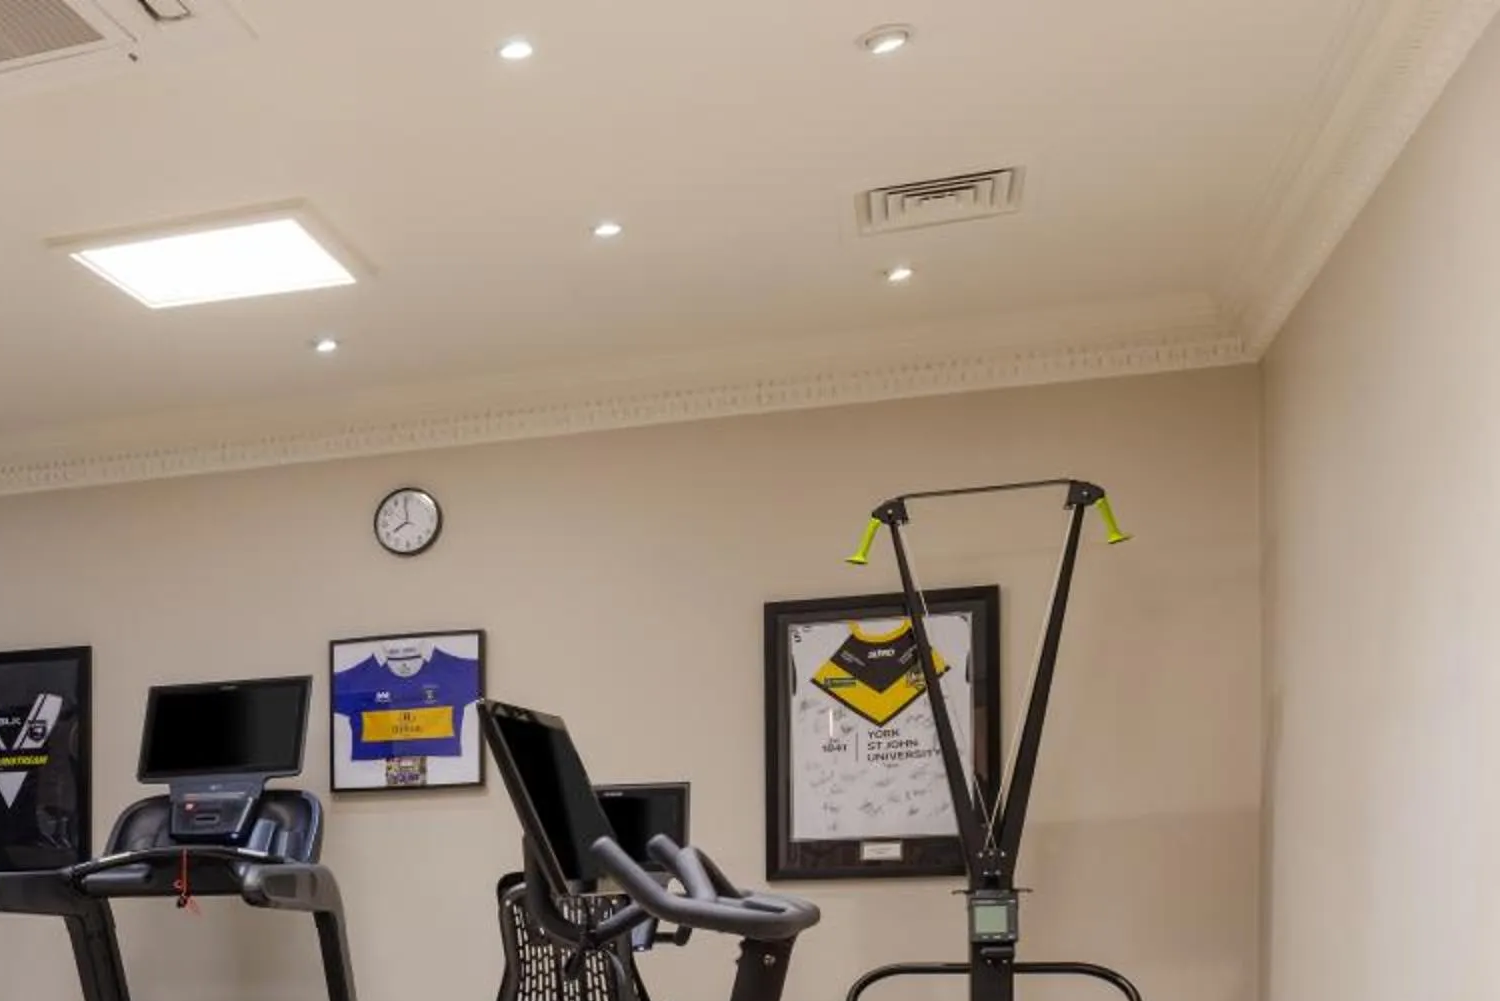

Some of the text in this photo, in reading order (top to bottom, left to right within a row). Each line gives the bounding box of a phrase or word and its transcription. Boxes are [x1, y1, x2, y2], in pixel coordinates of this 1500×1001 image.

[868, 729, 899, 739] YORK
[868, 739, 919, 750] ST JOHN
